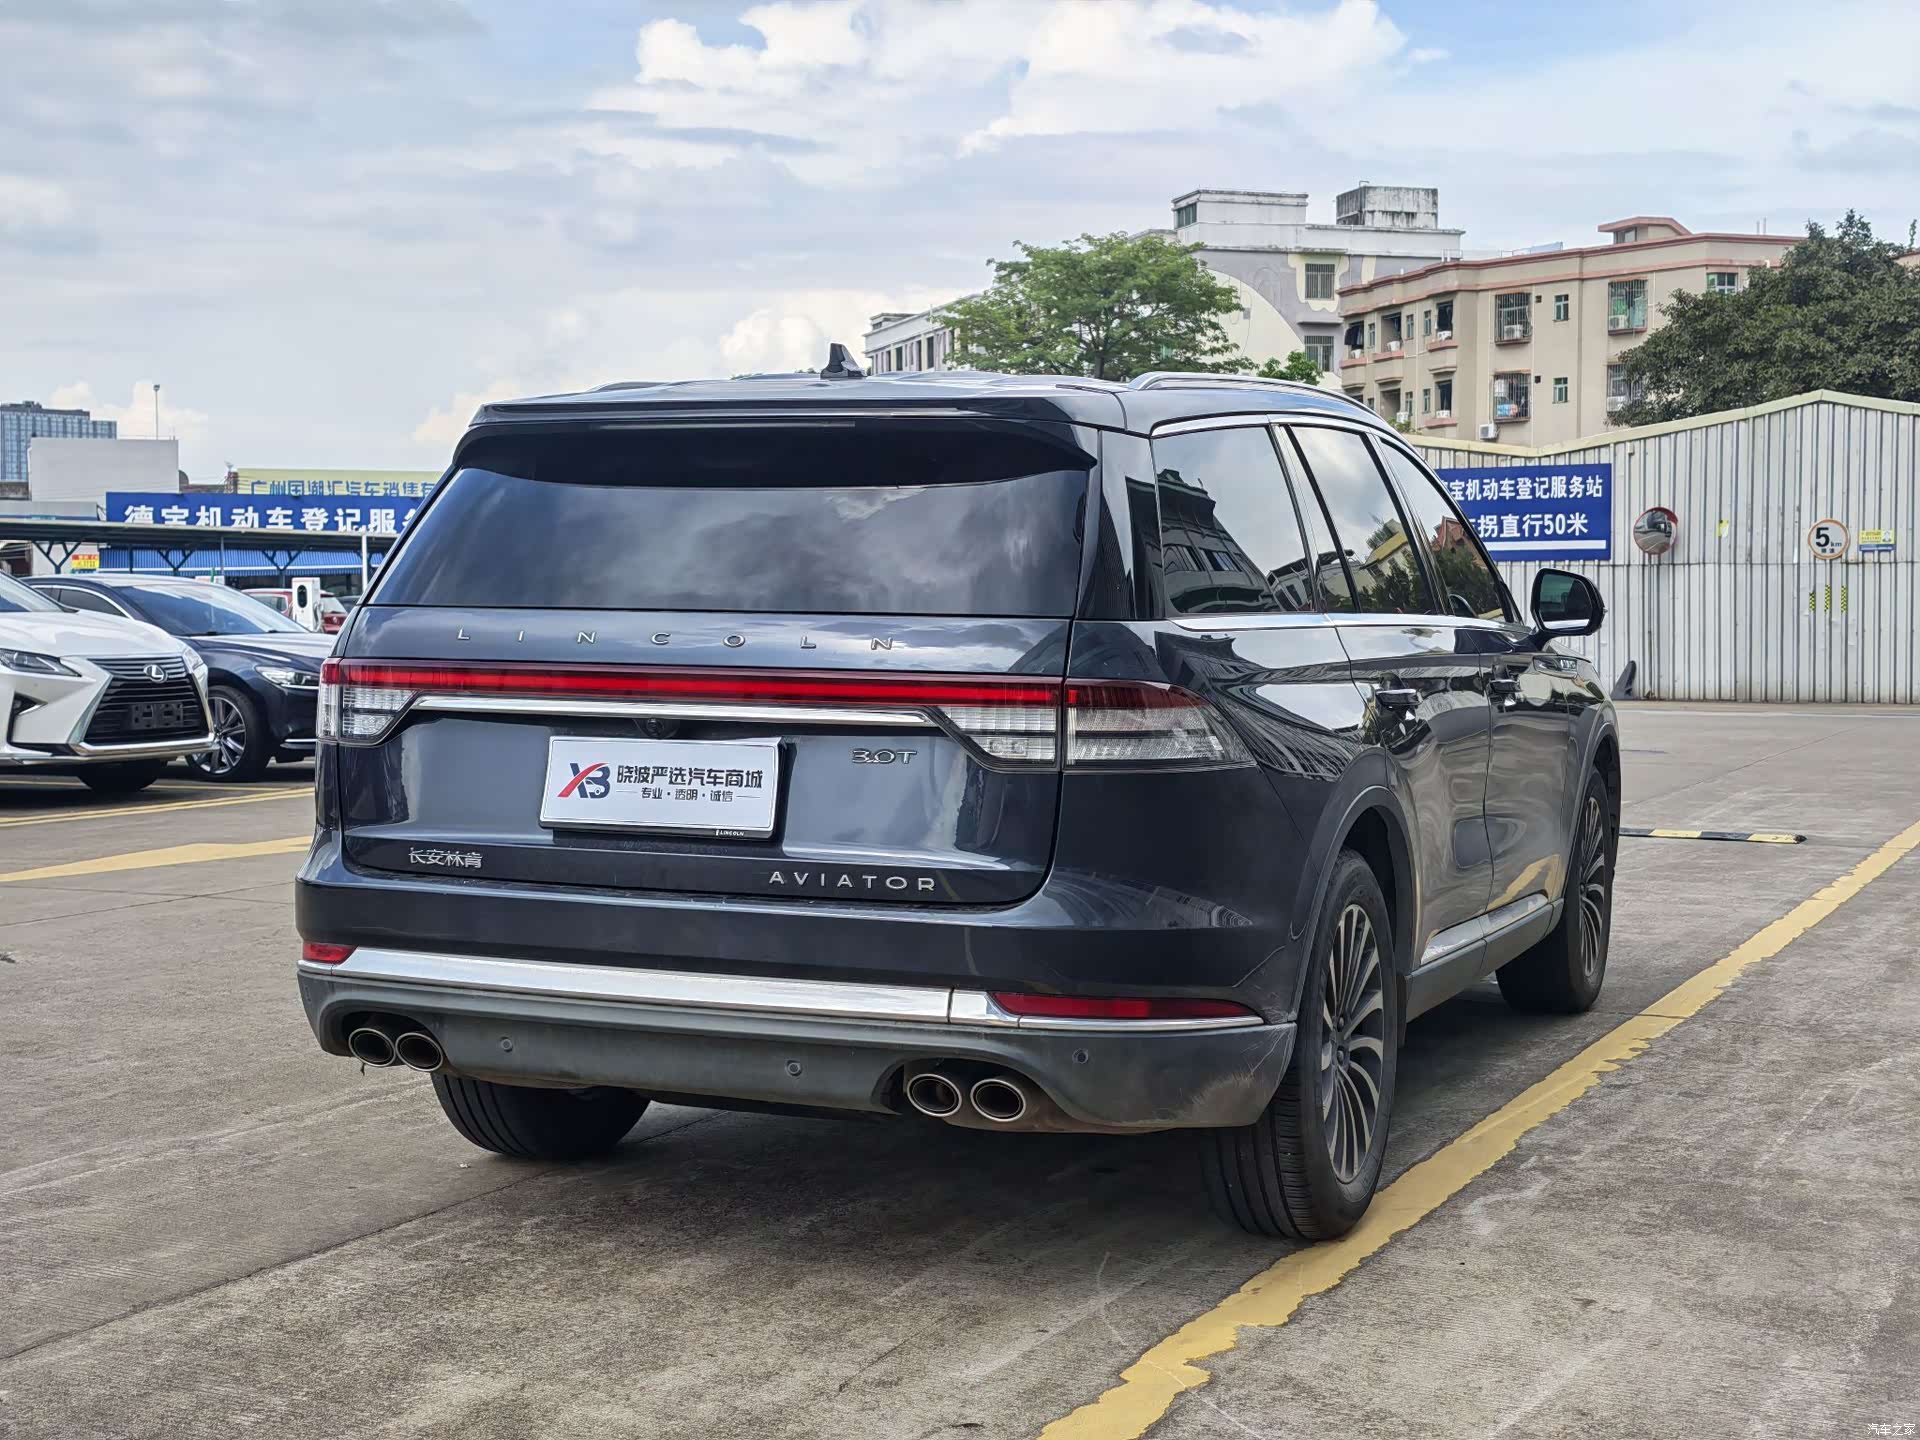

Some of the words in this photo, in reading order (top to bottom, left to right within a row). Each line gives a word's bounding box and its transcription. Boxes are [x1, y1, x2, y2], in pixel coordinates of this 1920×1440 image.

[1441, 474, 1603, 501] 宝机动车登记服务站
[457, 628, 894, 651] LINCOLN
[616, 765, 764, 788] 晓波严选汽车商城
[408, 847, 483, 869] 长安林肯
[769, 871, 935, 891] AVIATOR
